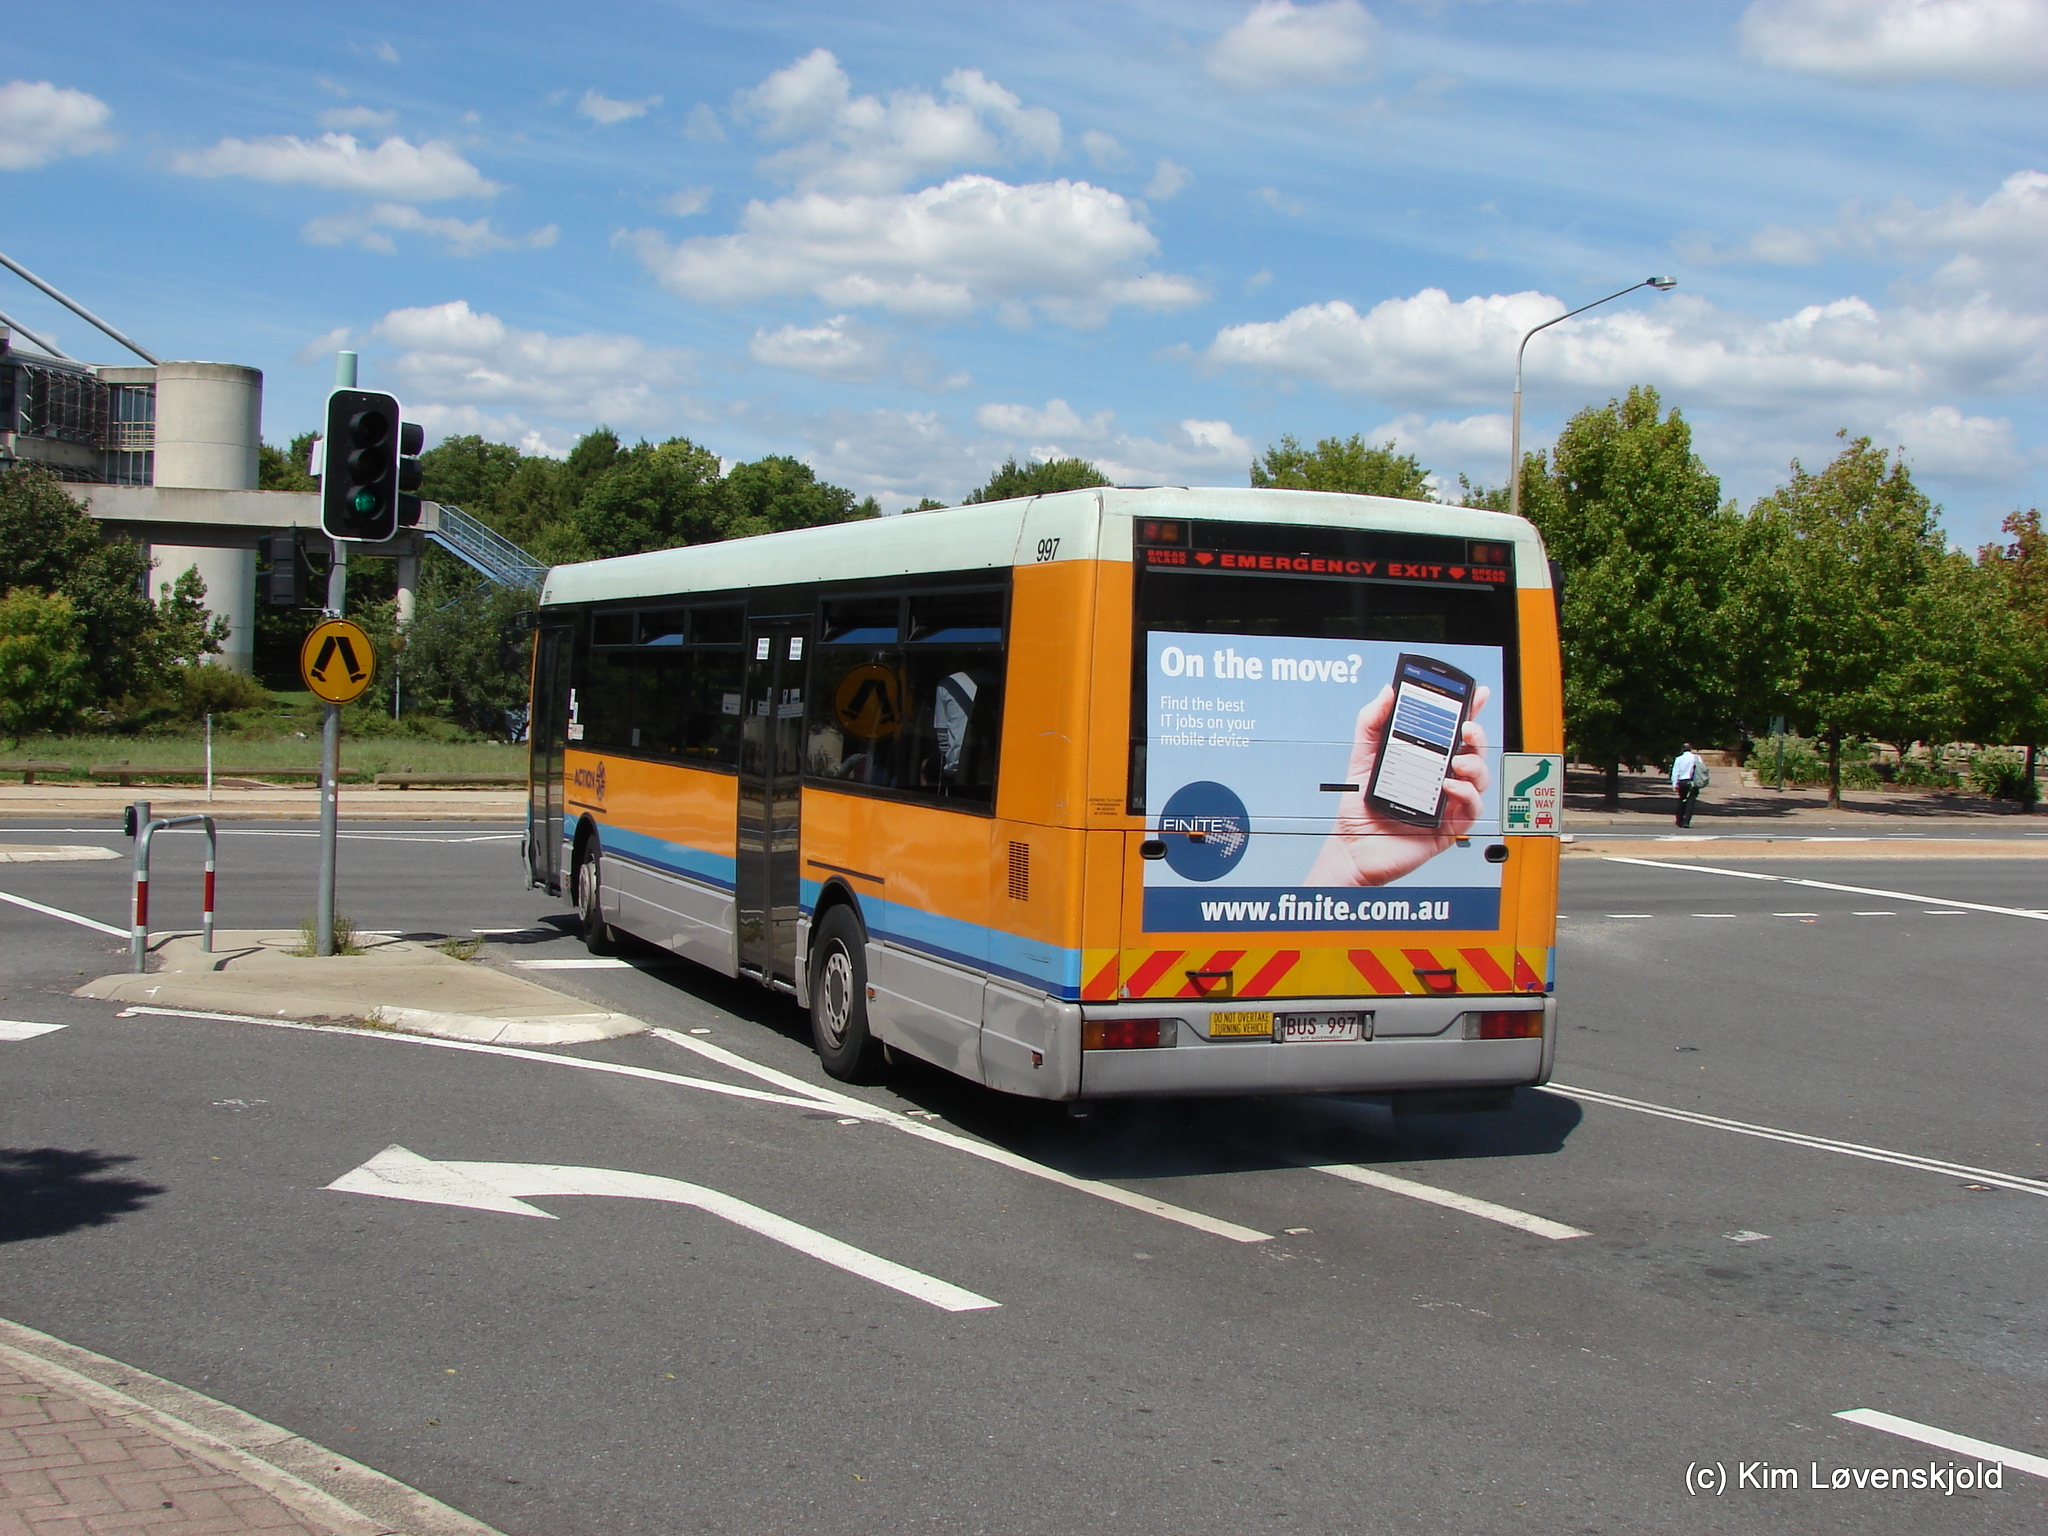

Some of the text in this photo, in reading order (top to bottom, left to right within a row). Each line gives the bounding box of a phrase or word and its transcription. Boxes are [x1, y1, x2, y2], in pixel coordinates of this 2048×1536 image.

[1036, 537, 1060, 562] 997
[1147, 549, 1187, 558] BREAK
[1149, 556, 1187, 565] GLASS
[1220, 553, 1442, 579] EMERGENCY EXIT
[1471, 568, 1506, 577] BREAK
[1472, 574, 1506, 583] GLASS
[1160, 646, 1363, 684] On the move?
[1160, 696, 1245, 712] Find the best
[1160, 713, 1256, 732] IT jobs on your
[1160, 732, 1250, 747] mobile device
[574, 768, 595, 789] ACTION
[1534, 787, 1556, 797] GIVE
[1534, 799, 1555, 809] WAY
[1163, 816, 1223, 832] FINITE
[1201, 894, 1450, 921] www.finite.com.au
[1213, 1011, 1270, 1023] DO NOT OVERTAKE
[1214, 1023, 1269, 1034] TURNING VEHICLE
[1286, 1016, 1356, 1036] BUS 997
